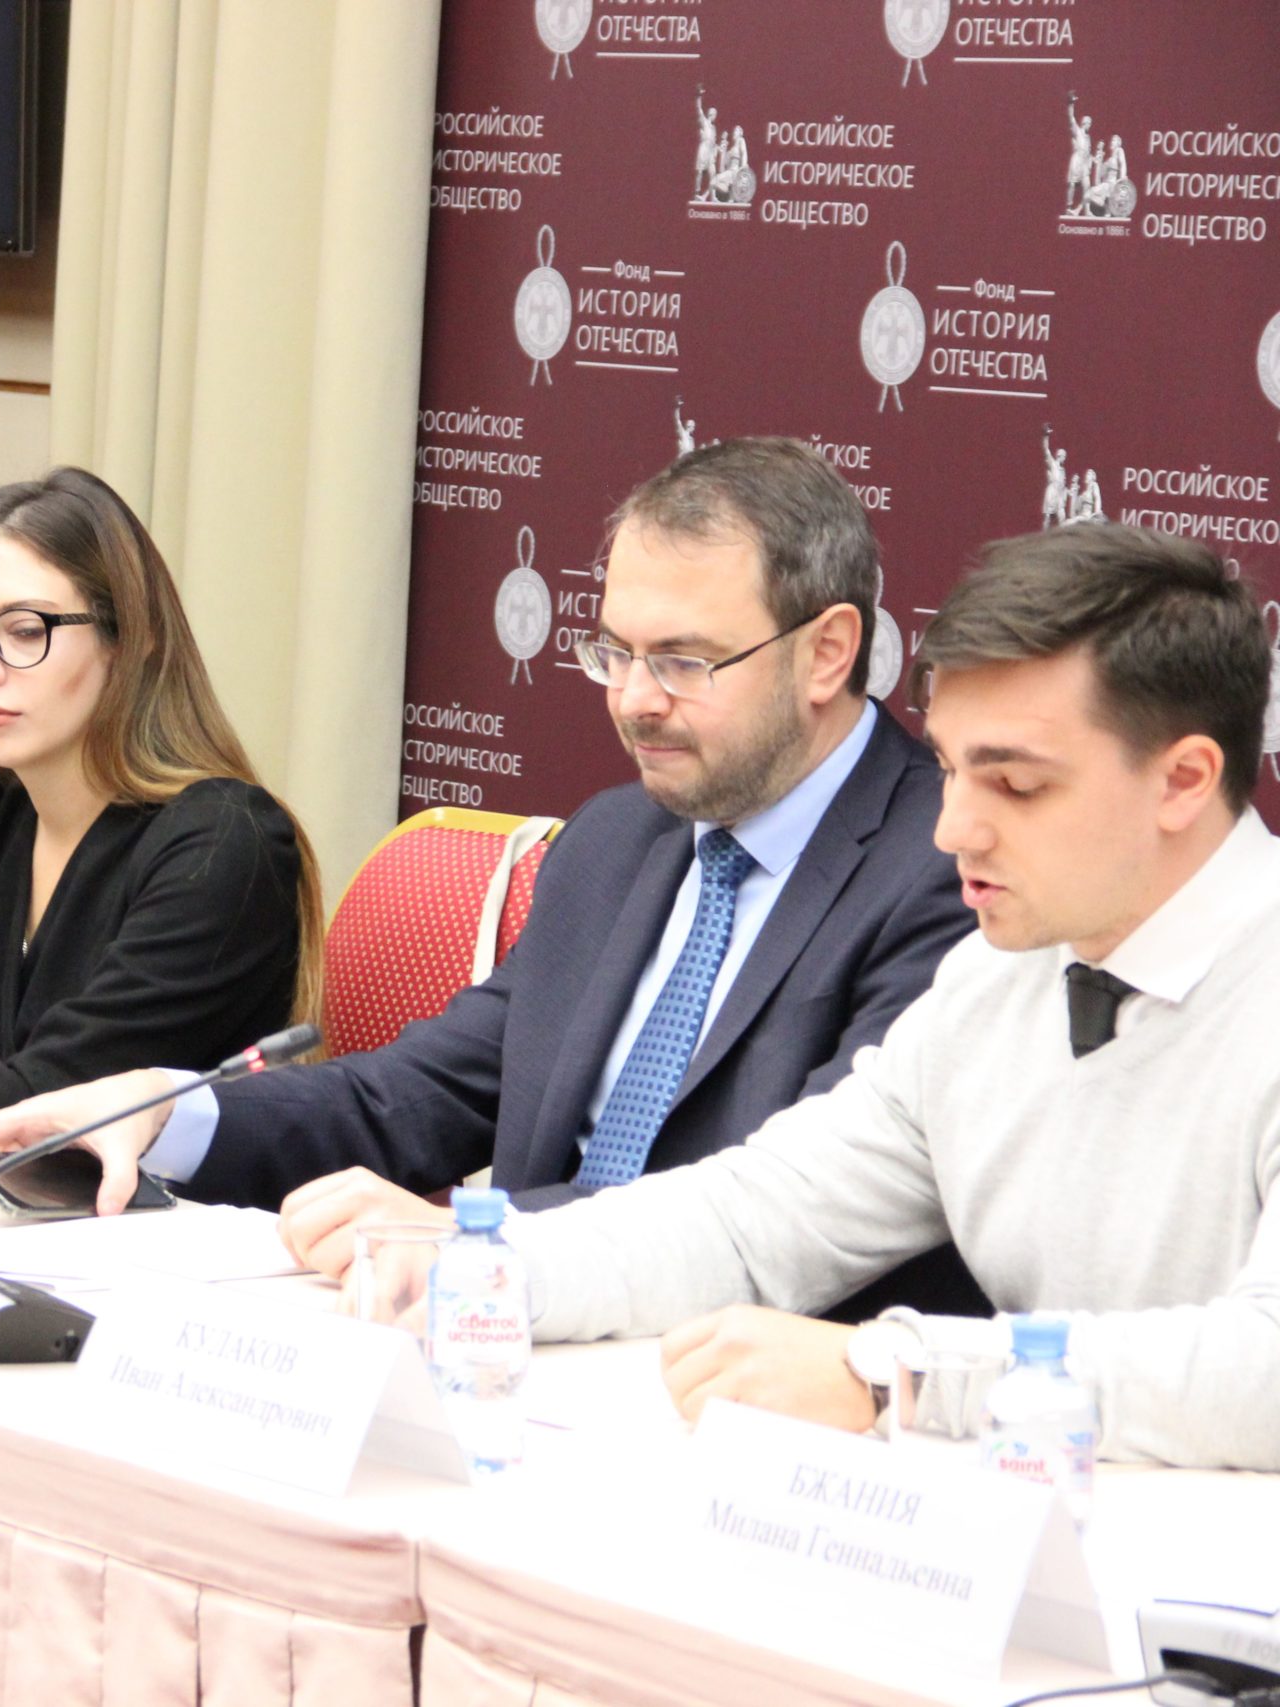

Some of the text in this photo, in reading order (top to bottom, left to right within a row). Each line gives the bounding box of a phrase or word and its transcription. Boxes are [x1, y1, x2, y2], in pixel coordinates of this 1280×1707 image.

[598, 14, 701, 42] ОТЕЧЕСТВА
[955, 17, 1074, 46] ОТЕЧЕСТВА
[766, 115, 896, 148] РОССИЙСКОЕ
[1149, 123, 1280, 157] РОССИЙСКО
[763, 161, 916, 188] ИСТОРИЧЕСКОЕ
[1145, 172, 1280, 200] ИСТОРИЧЕС
[761, 199, 870, 230] ОБЩЕСТВО
[1143, 213, 1267, 247] ОБЩЕСТВО
[614, 259, 651, 283] Фонд
[579, 287, 682, 319] ИСТОРИЯ
[975, 277, 1016, 303] Фонд
[576, 324, 680, 357] ОТЕЧЕСТВА
[933, 308, 1051, 341] ИСТОРИЯ
[930, 347, 1048, 382] ОТЕЧЕСТВА
[1123, 464, 1270, 502] РОССИЙСКОЕ
[1121, 508, 1280, 545] ИСТОРИЧЕСКО
[404, 702, 505, 738] ОССИЙСКОЕ
[404, 739, 523, 777] СТОРИЧЕСКОЕ
[402, 774, 484, 806] БЩЕСТВО
[175, 1319, 300, 1374] КУЛАКОВ
[108, 1352, 333, 1438] Иван Александрович
[786, 1461, 924, 1527] БЖАНИЯ
[702, 1496, 802, 1554] Милана
